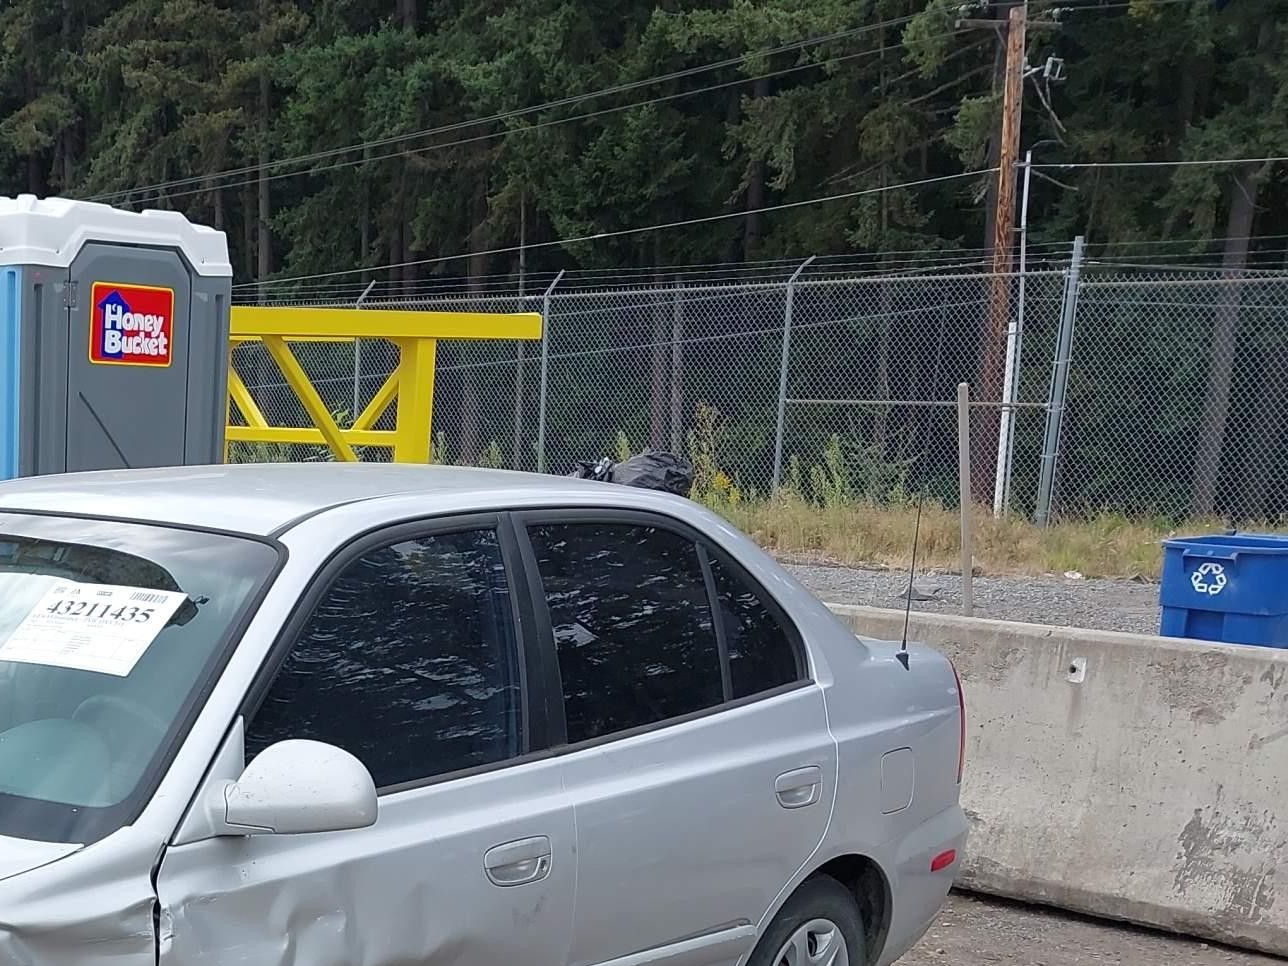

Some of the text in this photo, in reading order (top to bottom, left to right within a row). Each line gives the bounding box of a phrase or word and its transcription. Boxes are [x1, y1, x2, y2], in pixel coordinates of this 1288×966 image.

[104, 303, 164, 336] Honey
[104, 328, 168, 356] Bucket
[46, 599, 155, 623] 43211435
